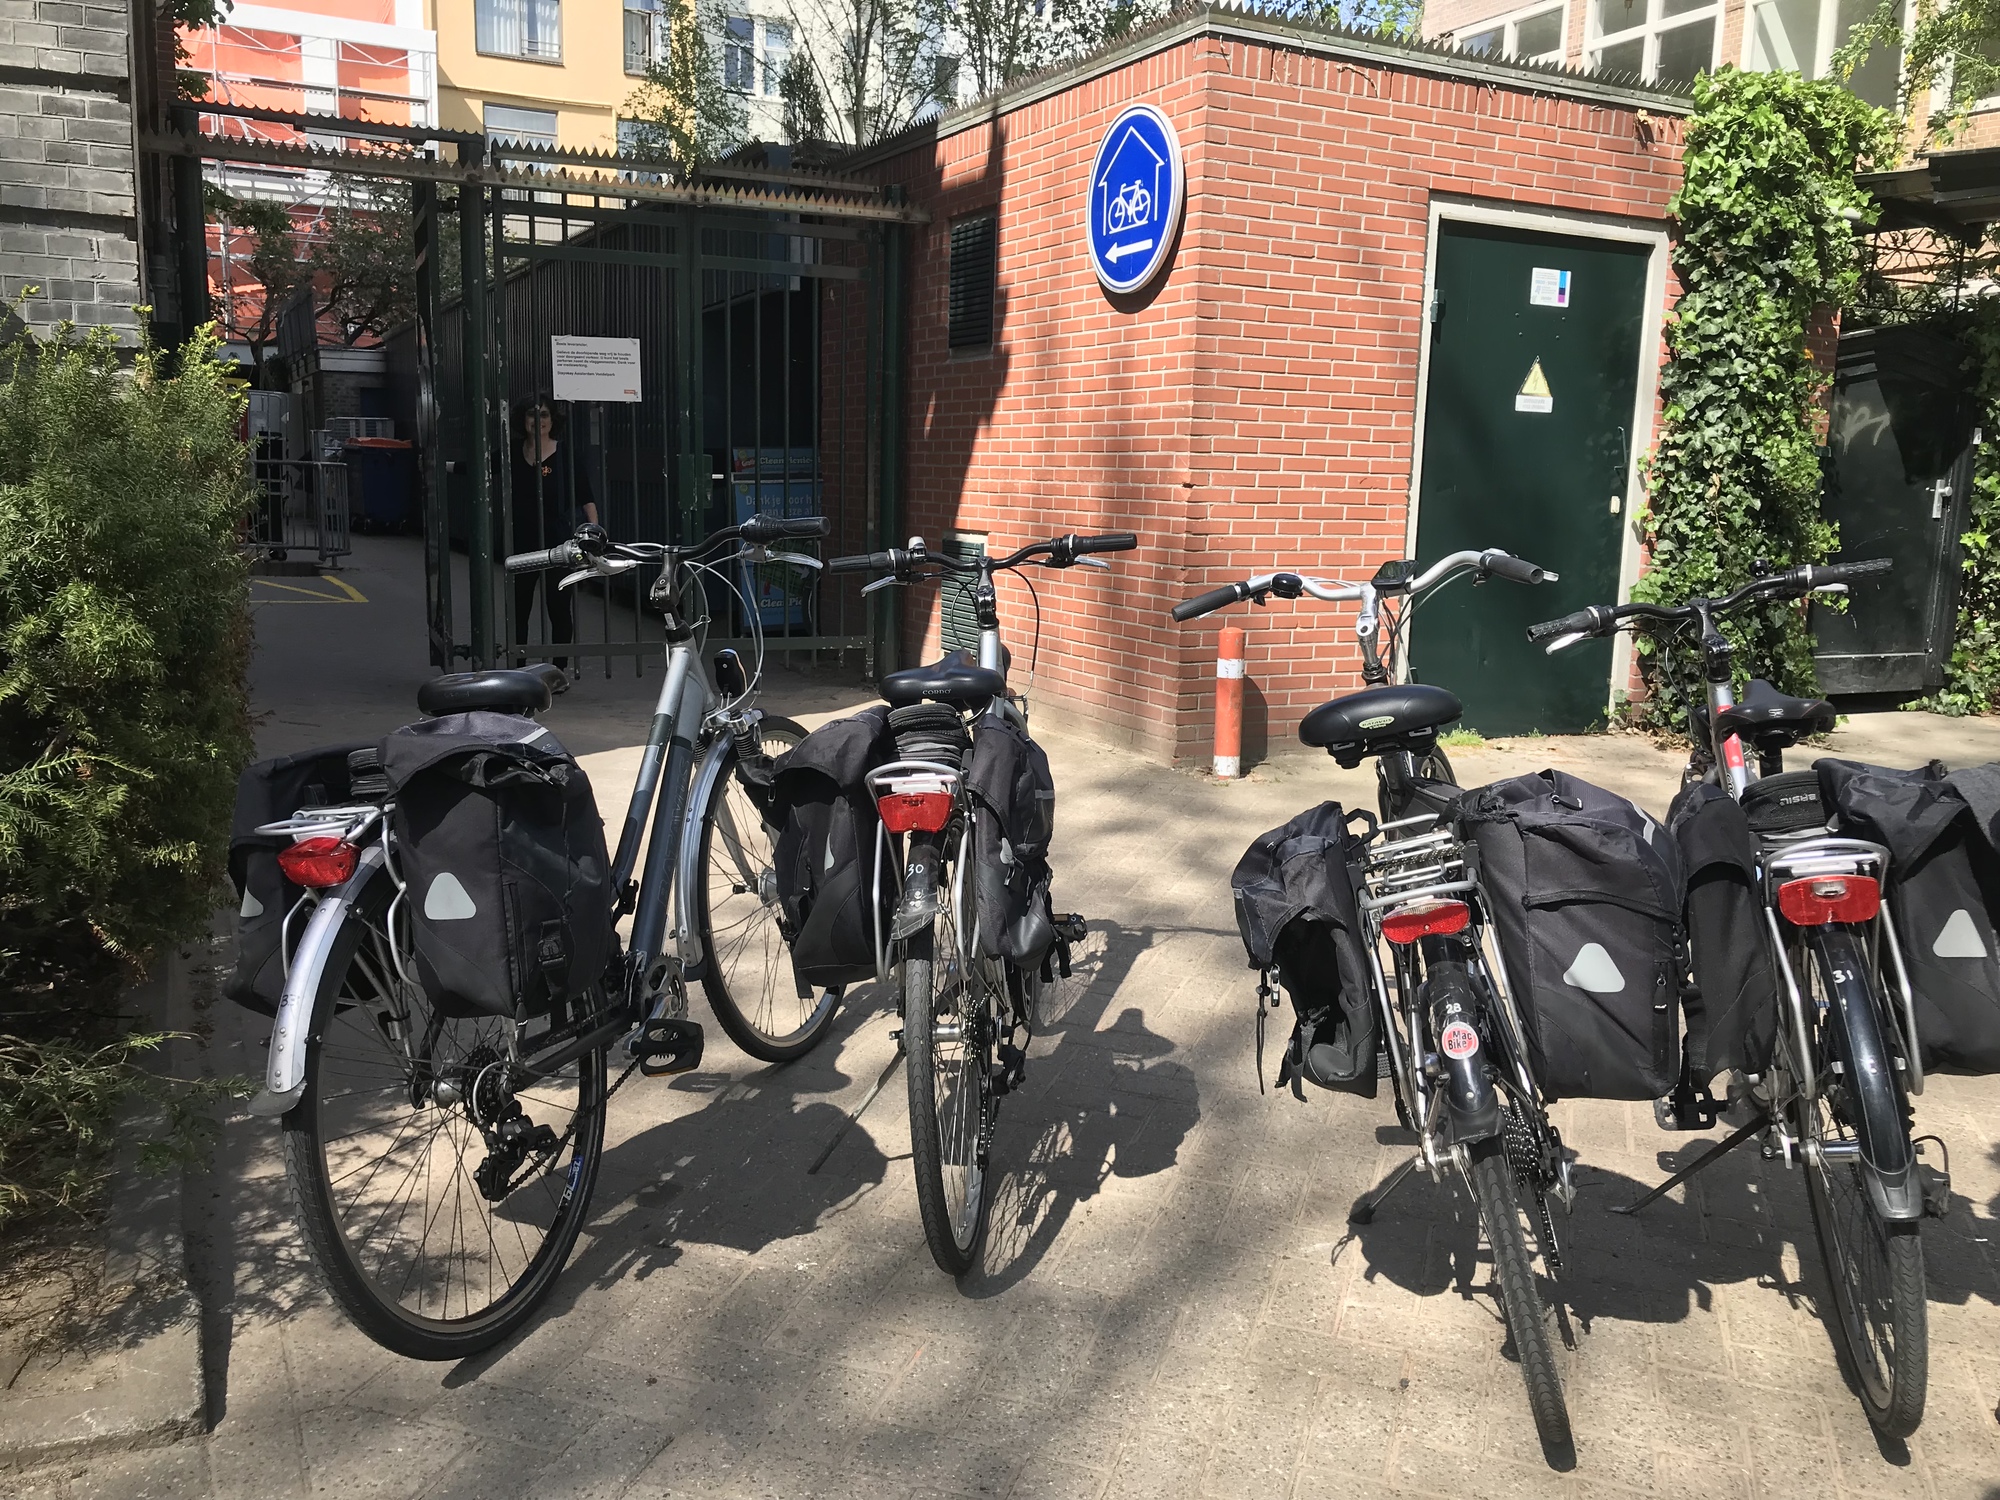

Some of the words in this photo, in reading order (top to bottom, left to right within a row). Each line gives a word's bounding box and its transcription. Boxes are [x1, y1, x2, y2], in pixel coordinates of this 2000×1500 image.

[772, 494, 782, 508] je
[805, 493, 821, 504] ht
[905, 863, 925, 882] 30
[1832, 969, 1854, 984] 31
[1452, 1030, 1472, 1040] Mac
[1447, 1038, 1467, 1050] Bike
